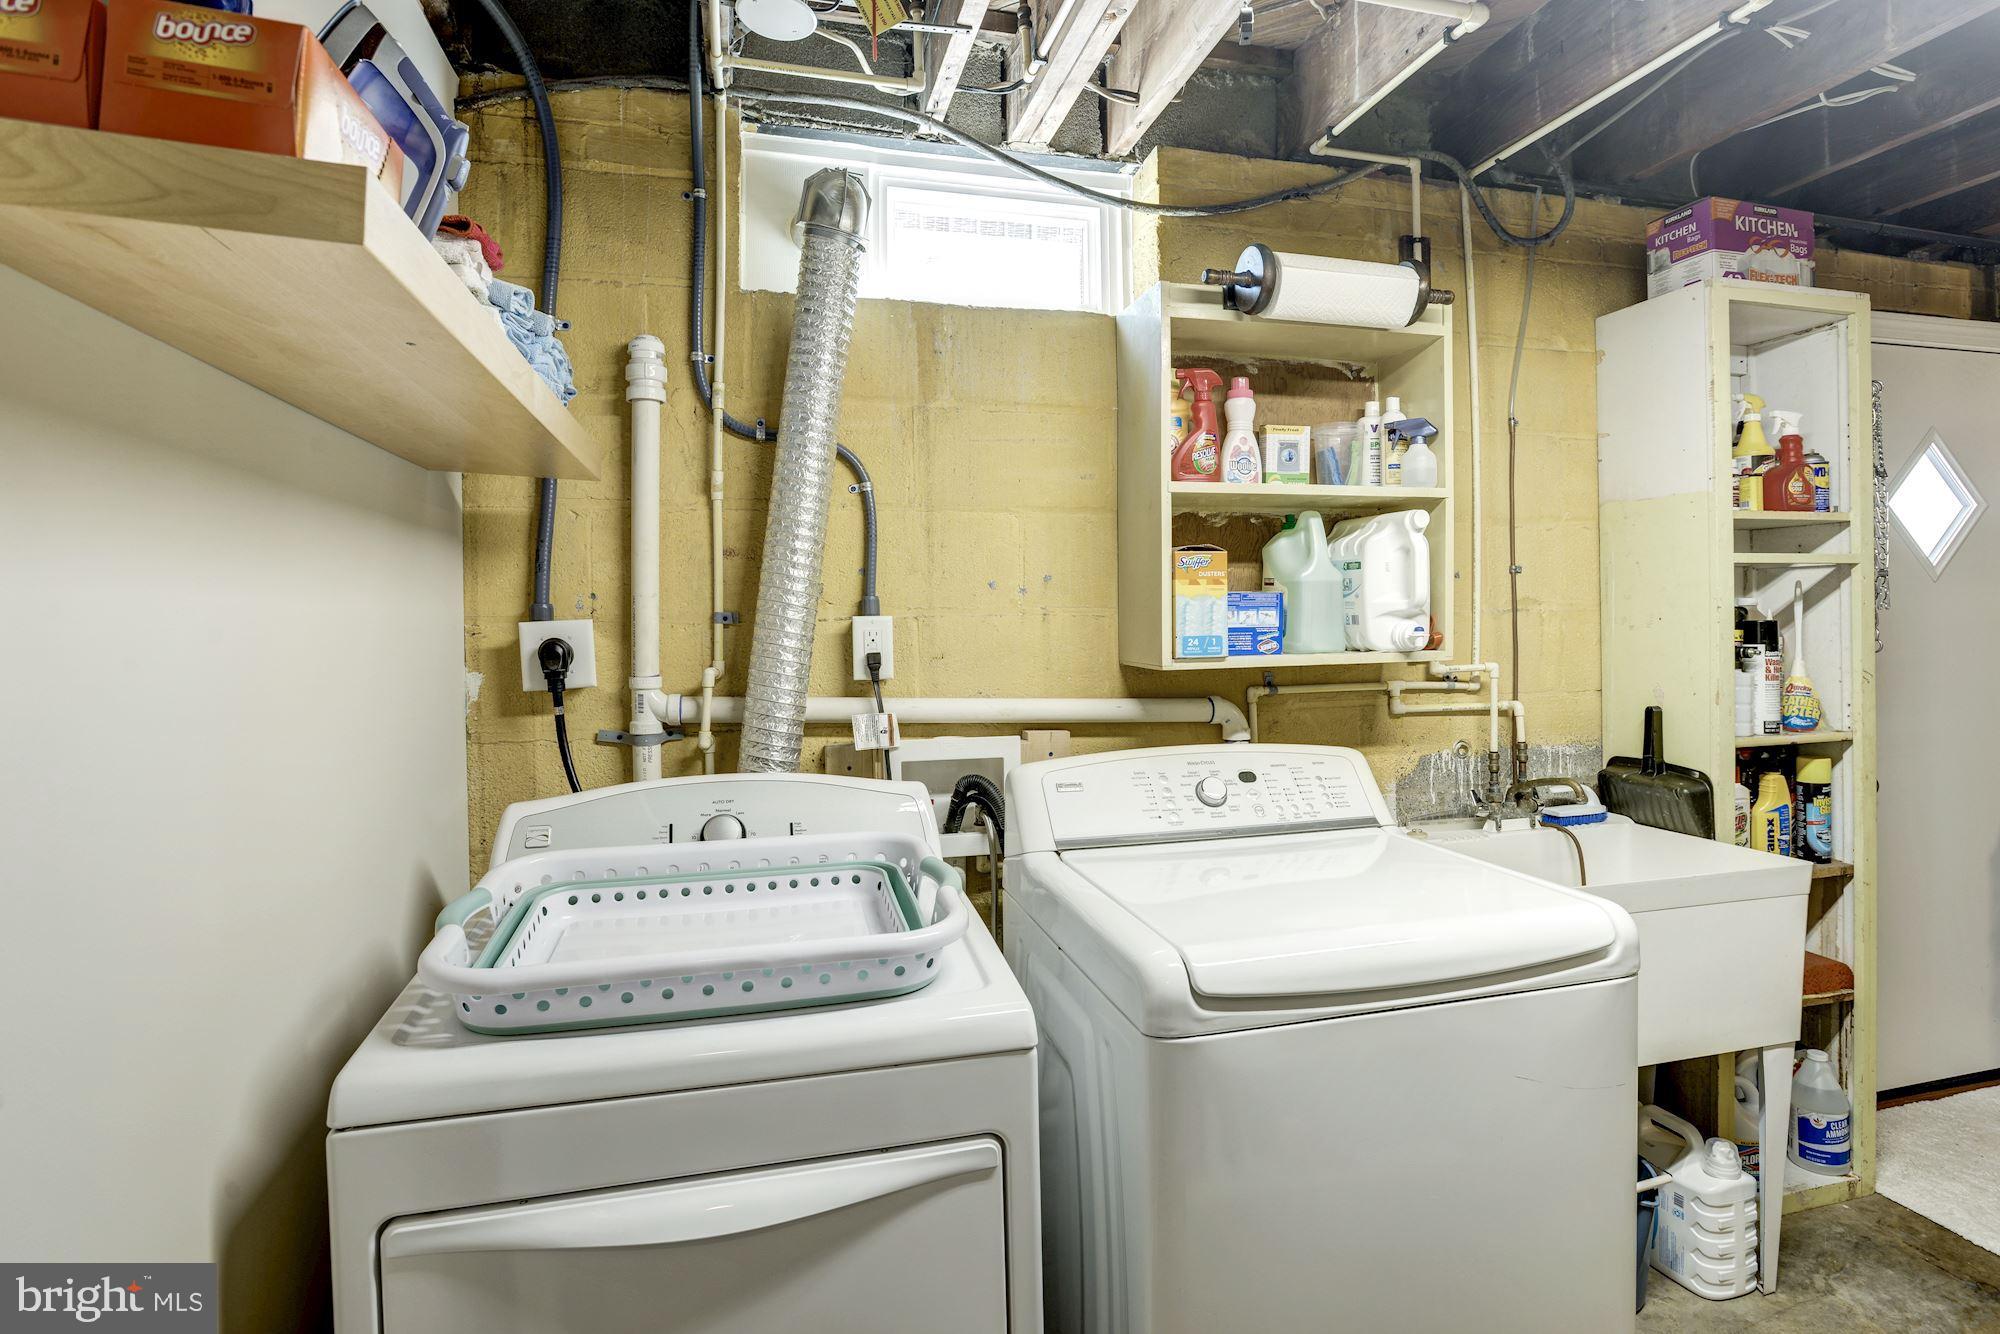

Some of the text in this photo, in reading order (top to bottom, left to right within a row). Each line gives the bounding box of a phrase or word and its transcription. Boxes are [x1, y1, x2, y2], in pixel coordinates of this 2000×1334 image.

[156, 14, 252, 44] bounce
[341, 103, 381, 161] bounce
[1664, 208, 1693, 225] KIRKLAND
[1754, 206, 1777, 215] KIRKLAND
[1735, 215, 1799, 238] KITCHEN
[1655, 222, 1697, 247] KITCHEN
[1687, 234, 1702, 244] Bags
[1790, 243, 1808, 256] Bags
[1370, 424, 1379, 433] V
[1192, 446, 1216, 461] RESOLVE
[1178, 555, 1211, 569] Swiffer
[1187, 638, 1199, 646] 24
[1783, 695, 1820, 709] EATHER
[1783, 705, 1821, 720] USTER
[1830, 1119, 1848, 1131] CLEAR
